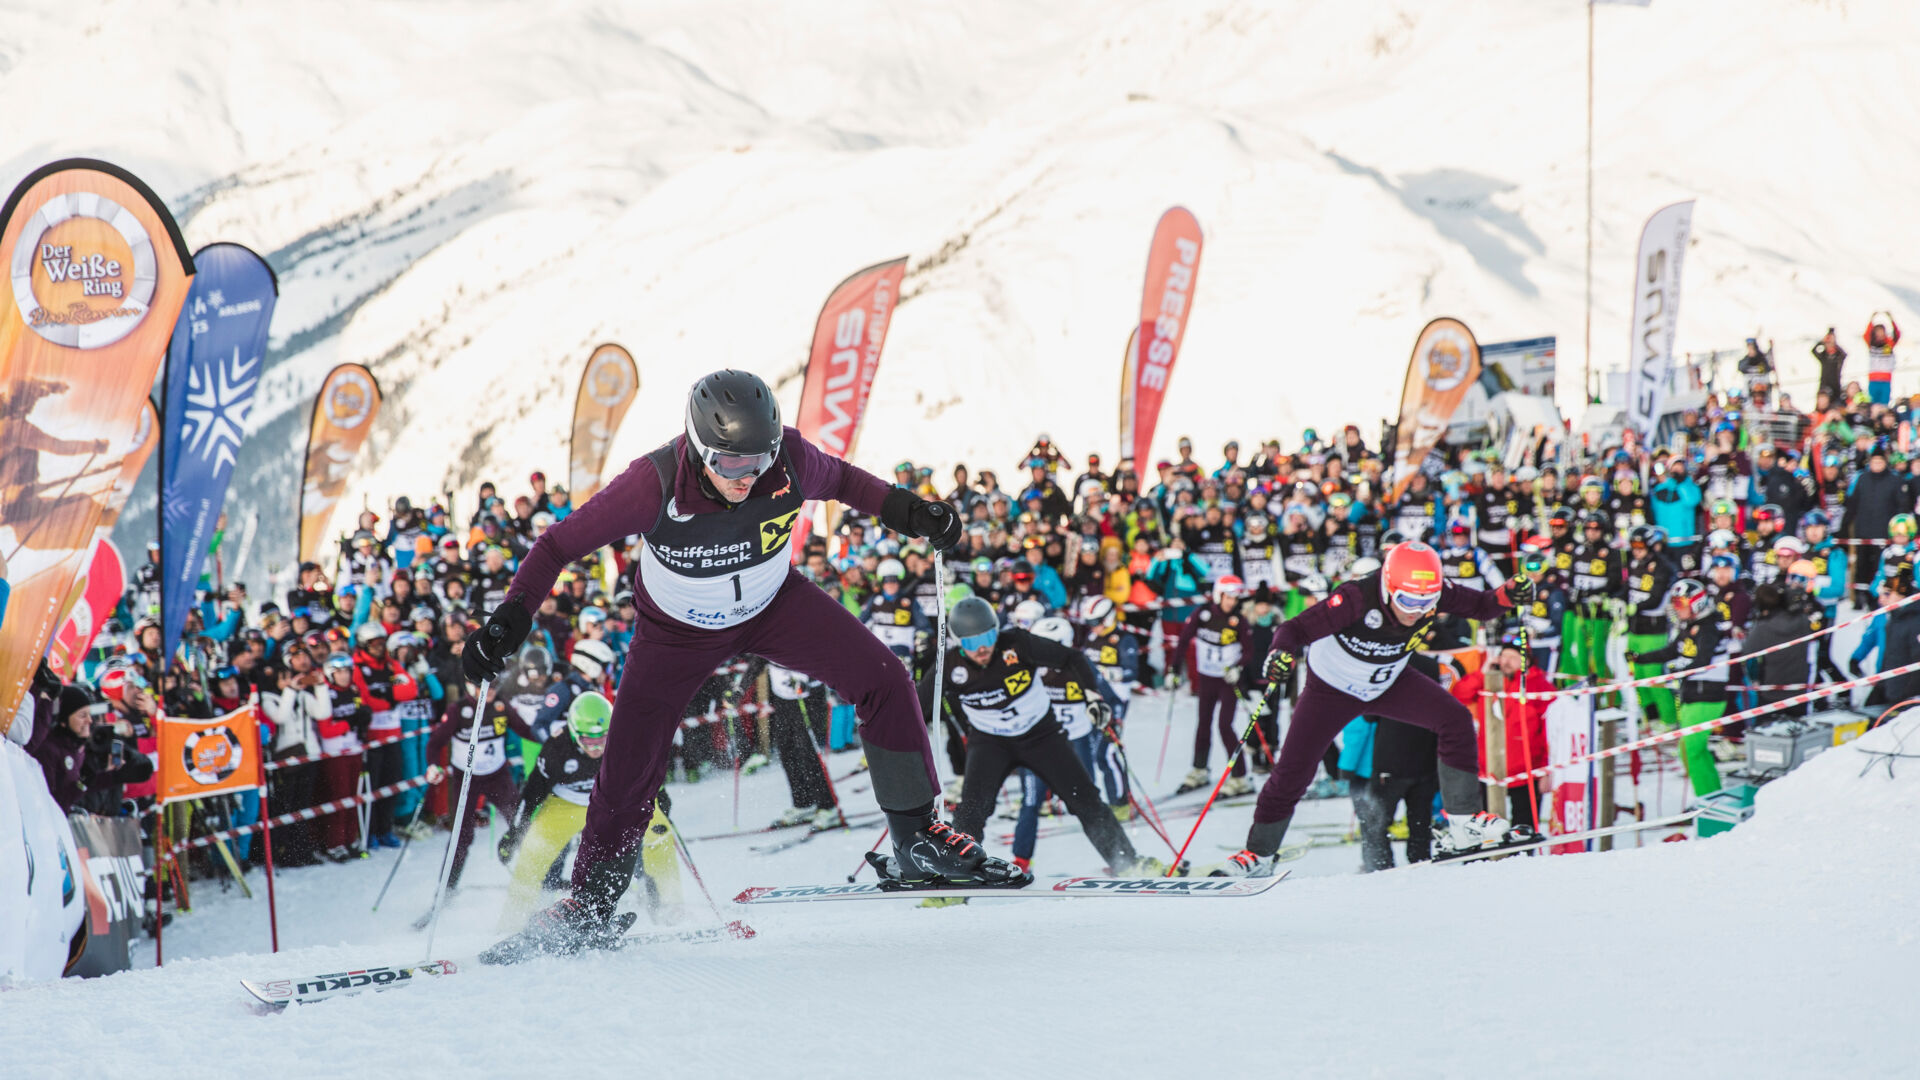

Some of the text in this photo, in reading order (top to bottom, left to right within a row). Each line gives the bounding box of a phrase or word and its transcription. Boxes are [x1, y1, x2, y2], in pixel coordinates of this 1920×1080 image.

[41, 243, 72, 260] Der
[42, 253, 121, 283] Weiße
[82, 279, 123, 298] Ring
[1139, 236, 1199, 392] PRESSE
[817, 308, 866, 453] MUS
[658, 541, 751, 559] Raiffeisen
[701, 552, 752, 569] Bank
[728, 573, 742, 602] 1
[1368, 664, 1396, 684] 6
[466, 744, 476, 768] HEAD
[1065, 879, 1237, 891] STÖCKLI
[297, 968, 414, 995] TÖCKLI
